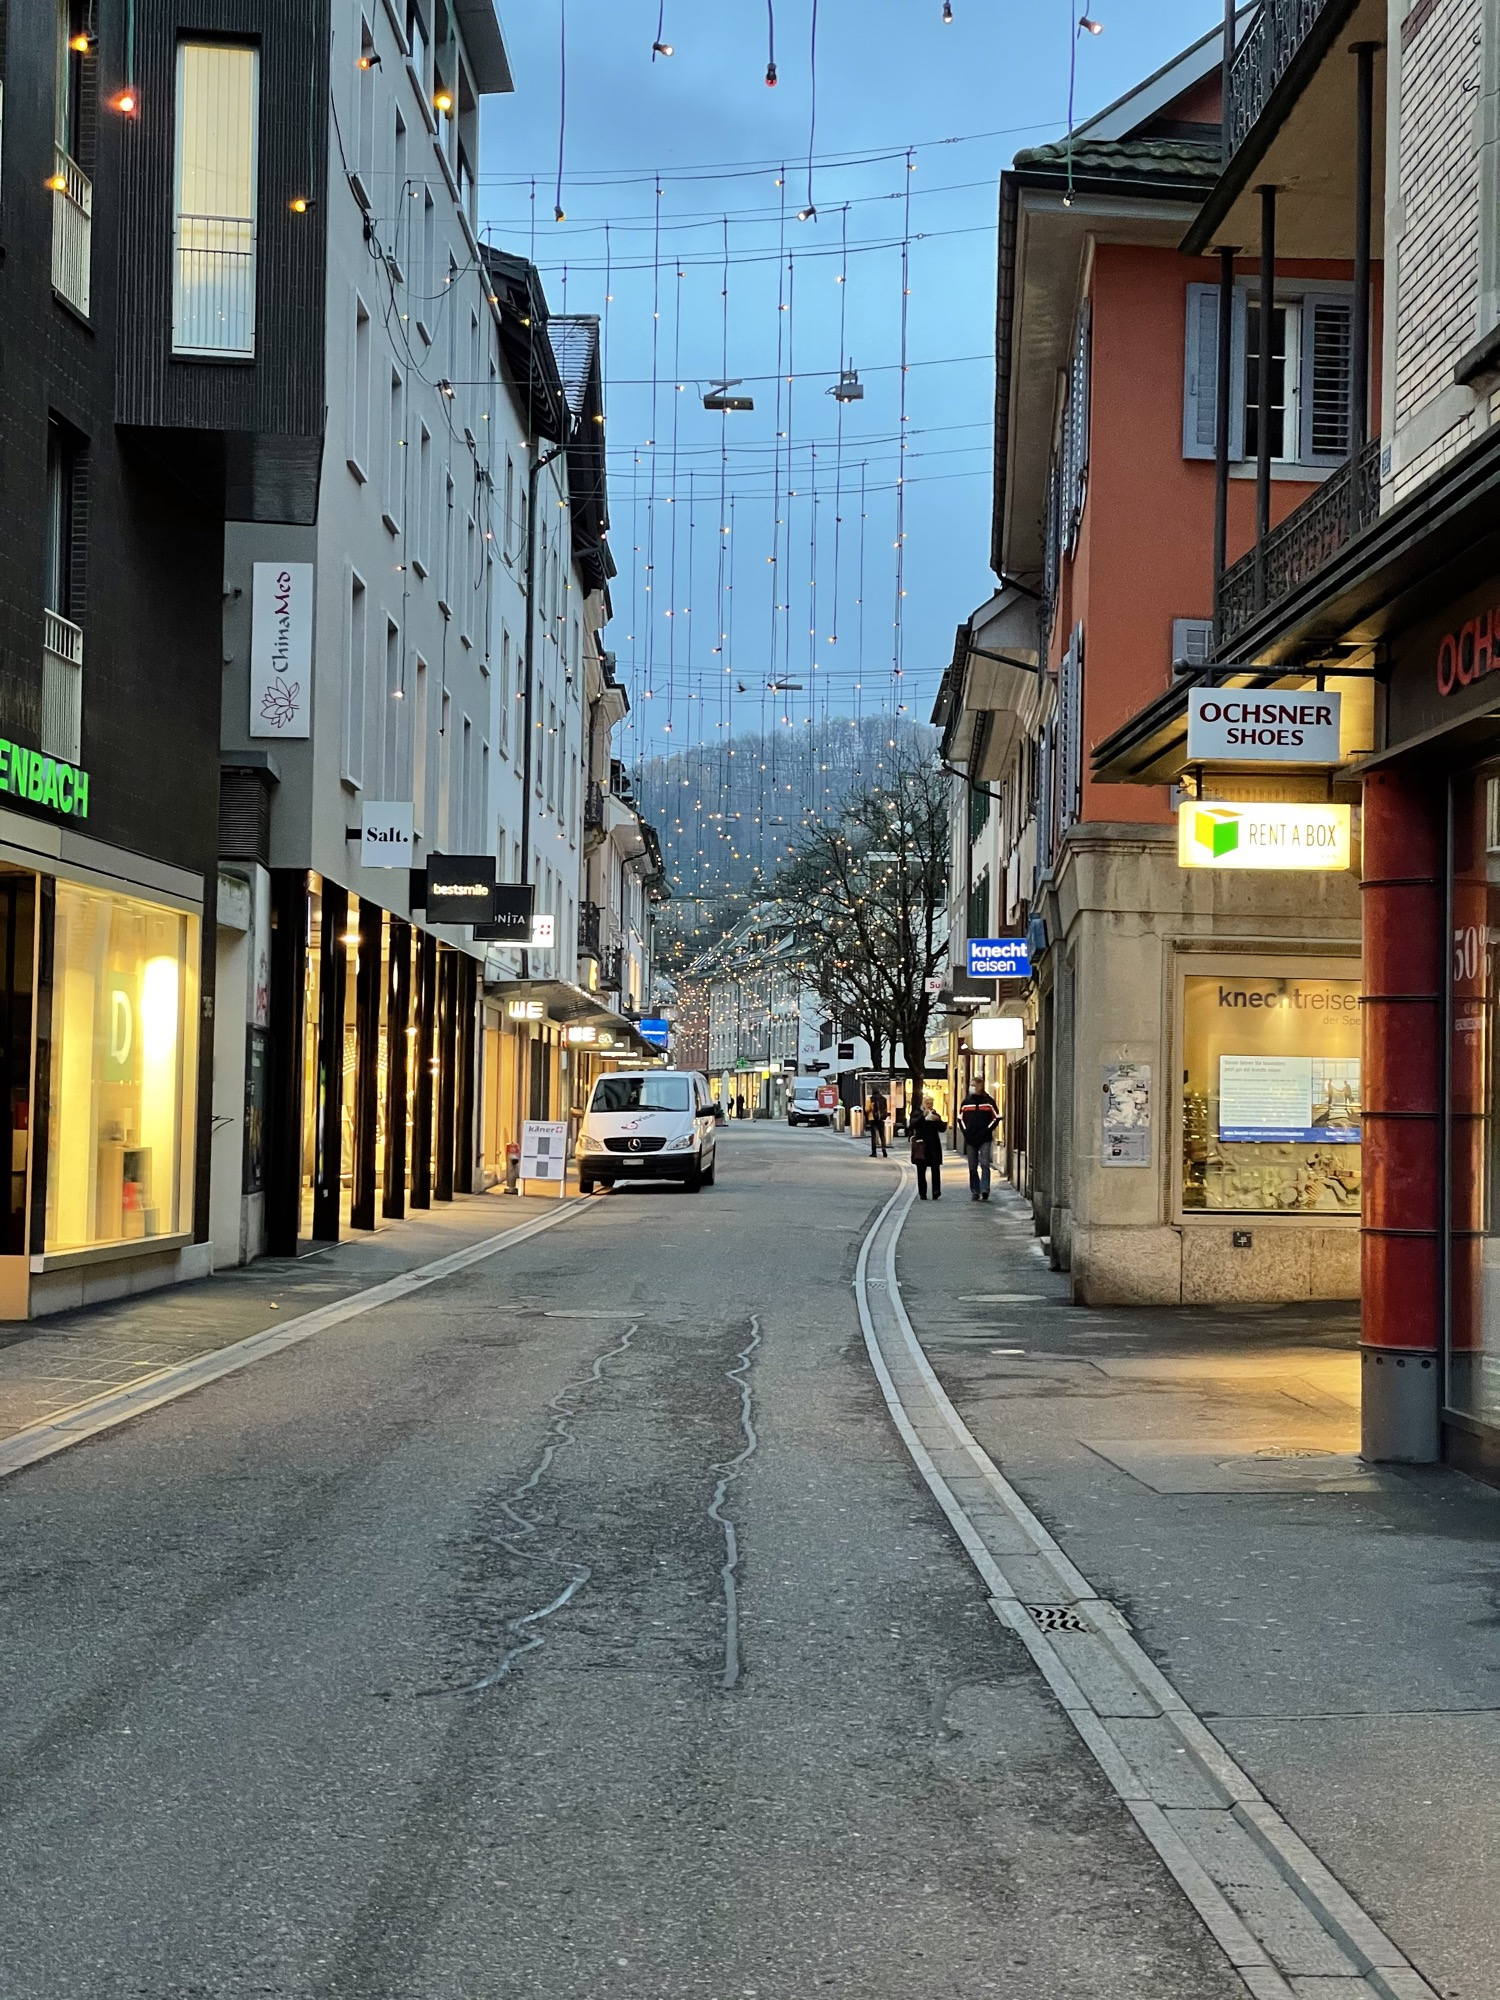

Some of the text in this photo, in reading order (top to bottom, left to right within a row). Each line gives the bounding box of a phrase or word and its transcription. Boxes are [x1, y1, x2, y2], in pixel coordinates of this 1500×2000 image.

[271, 571, 291, 673] ChinaMed
[1199, 702, 1333, 726] OCHSNER
[1226, 727, 1304, 746] SHOES
[366, 826, 409, 843] Salt.
[1249, 823, 1337, 847] RENT A BOX
[433, 883, 489, 896] bestsmile
[971, 942, 1028, 958] knecht
[971, 957, 1016, 972] reisen
[508, 1000, 544, 1019] WE
